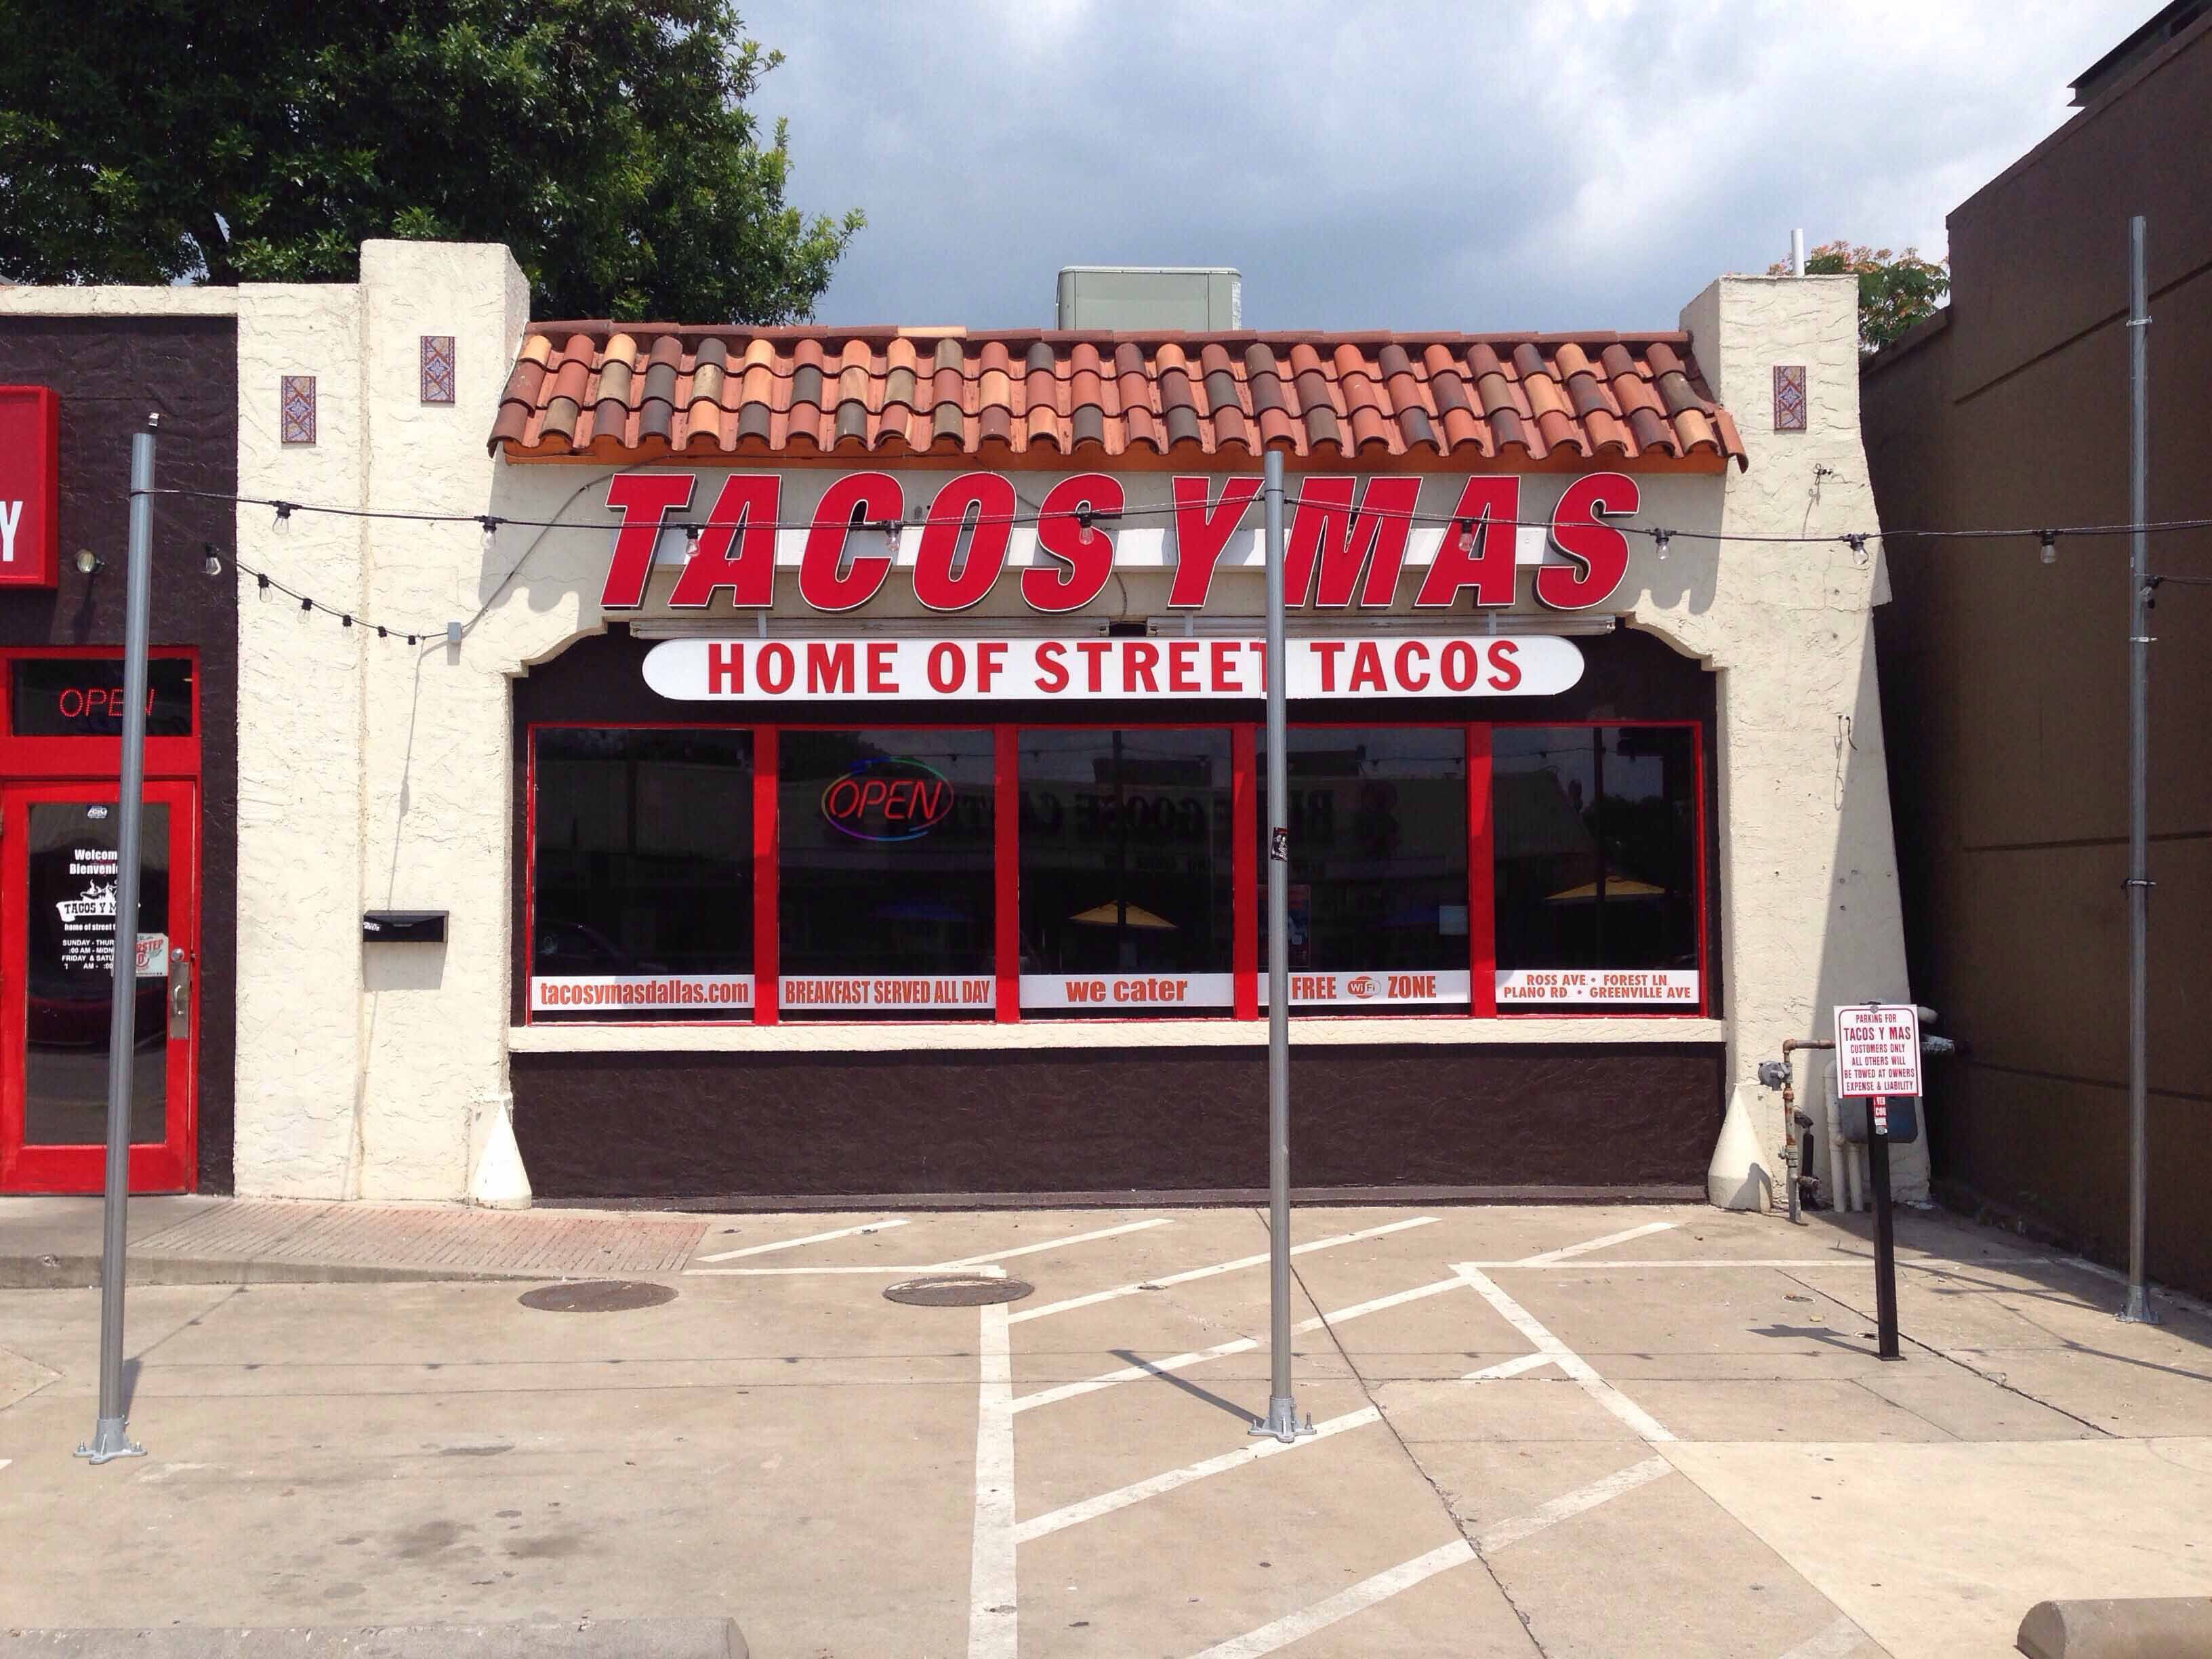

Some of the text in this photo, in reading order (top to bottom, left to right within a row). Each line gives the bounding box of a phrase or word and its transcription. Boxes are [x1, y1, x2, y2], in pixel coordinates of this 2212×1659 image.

[599, 472, 1641, 612] TACOS Y MAS
[708, 642, 899, 694] HOME
[927, 642, 1007, 694] OF
[1311, 640, 1522, 693] TACOS
[827, 779, 943, 819] OPEN
[75, 849, 118, 860] Welcom
[69, 863, 118, 874] Bienveni
[64, 902, 96, 914] TACOS
[100, 902, 106, 913] Y
[64, 923, 83, 931] home
[84, 923, 91, 931] of
[92, 923, 112, 931] street
[1526, 975, 1557, 985] ROSS
[1603, 975, 1647, 985] FOREST
[540, 980, 749, 1004] tacosymasdallas.com
[785, 981, 990, 1004] BREAKFAST SERVED ALL DAY
[1065, 977, 1188, 1002] we cater
[1292, 977, 1337, 1000] FREE
[1387, 975, 1437, 999] ZONE
[1504, 987, 1546, 998] PLANO
[1589, 987, 1662, 998] GREENVILLE
[1666, 987, 1691, 998] AVE
[1856, 1013, 1896, 1023] PARKING FOR
[1843, 1026, 1911, 1041] TACOS Y MAS
[1850, 1044, 1905, 1053] CUSTOMERS ONLY
[1851, 1056, 1906, 1066] ALL OTHERS WILL
[1844, 1068, 1914, 1078] BE TOWED AT OWNERS
[1847, 1081, 1913, 1091] EXPENSE & LIABILITY
